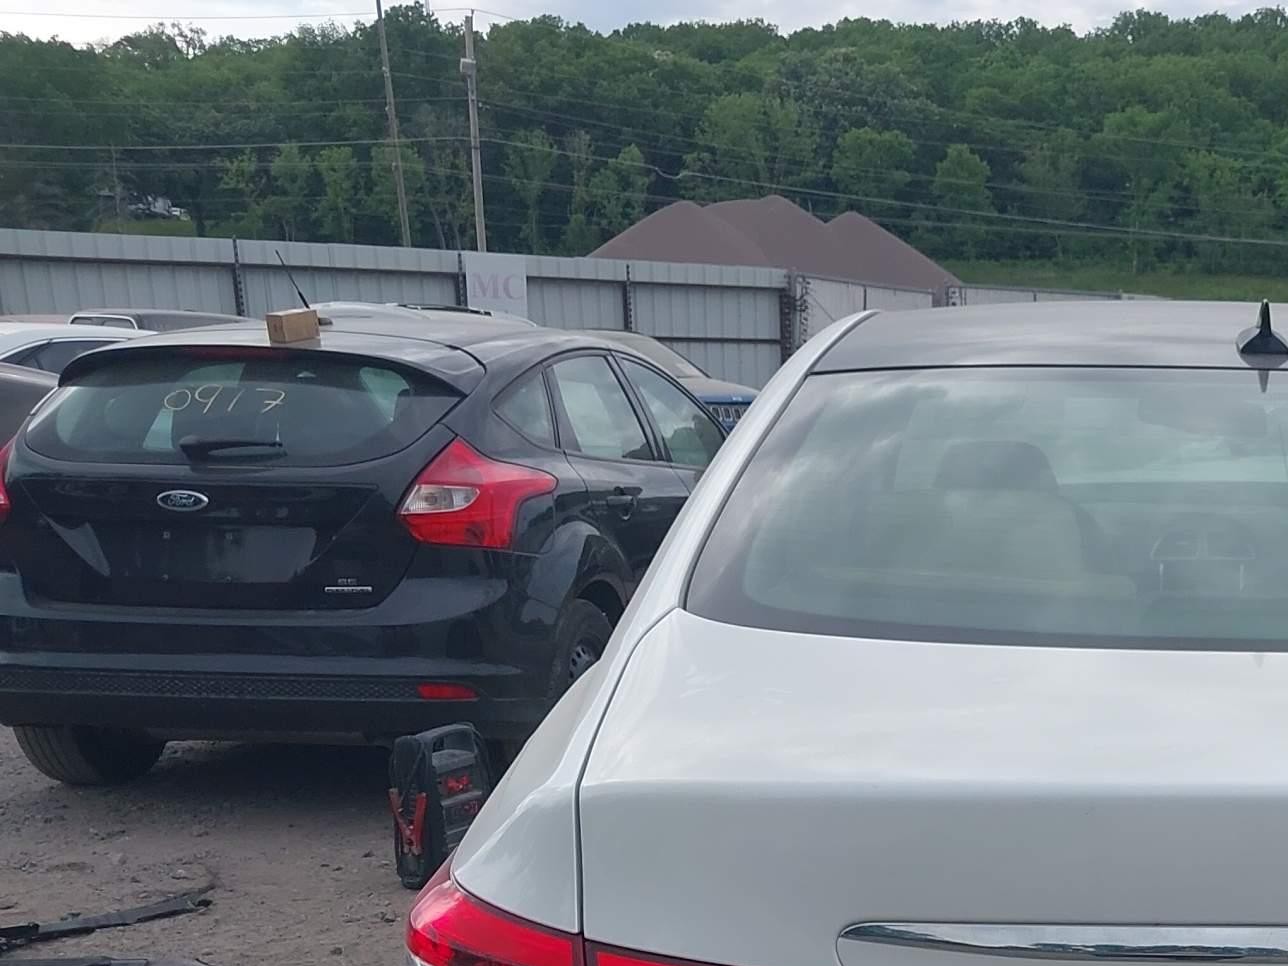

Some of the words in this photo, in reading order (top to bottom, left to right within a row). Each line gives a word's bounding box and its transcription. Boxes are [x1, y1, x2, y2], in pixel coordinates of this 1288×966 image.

[471, 272, 525, 300] MC
[163, 383, 286, 415] 0917
[167, 493, 196, 506] Ford
